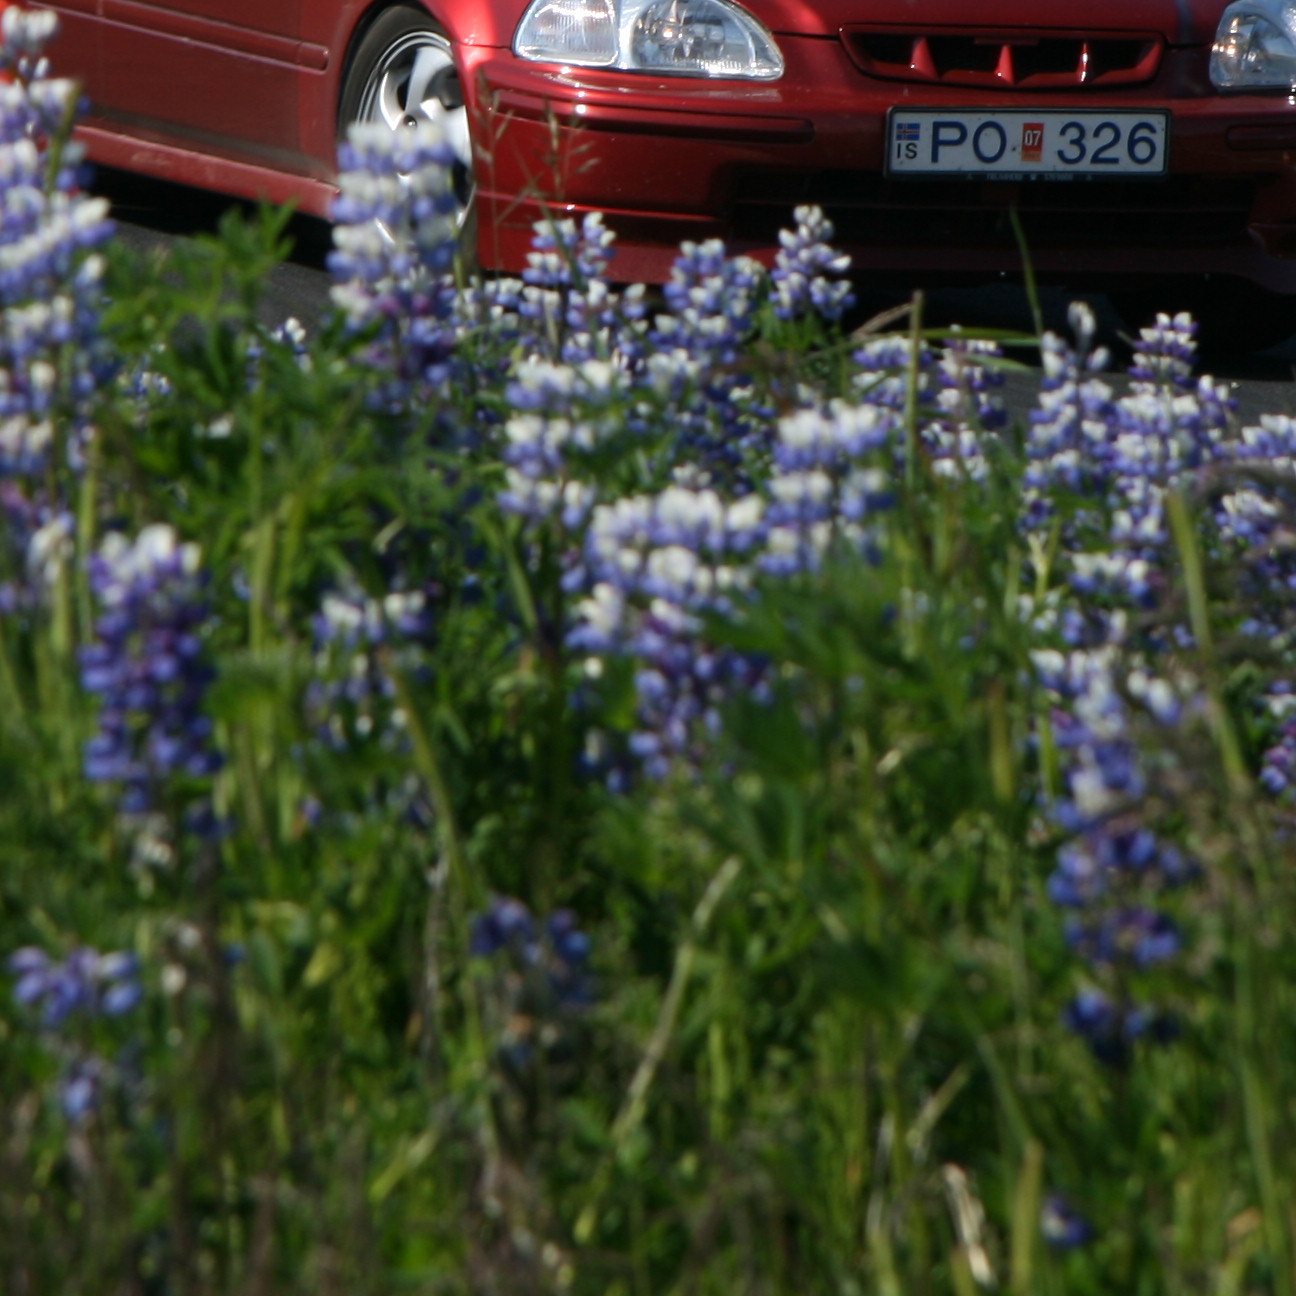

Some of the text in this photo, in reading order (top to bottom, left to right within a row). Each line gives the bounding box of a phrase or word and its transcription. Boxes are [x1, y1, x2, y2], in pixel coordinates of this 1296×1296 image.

[930, 120, 1158, 165] PO 326
[1024, 129, 1042, 147] 07
[896, 142, 918, 160] IS
